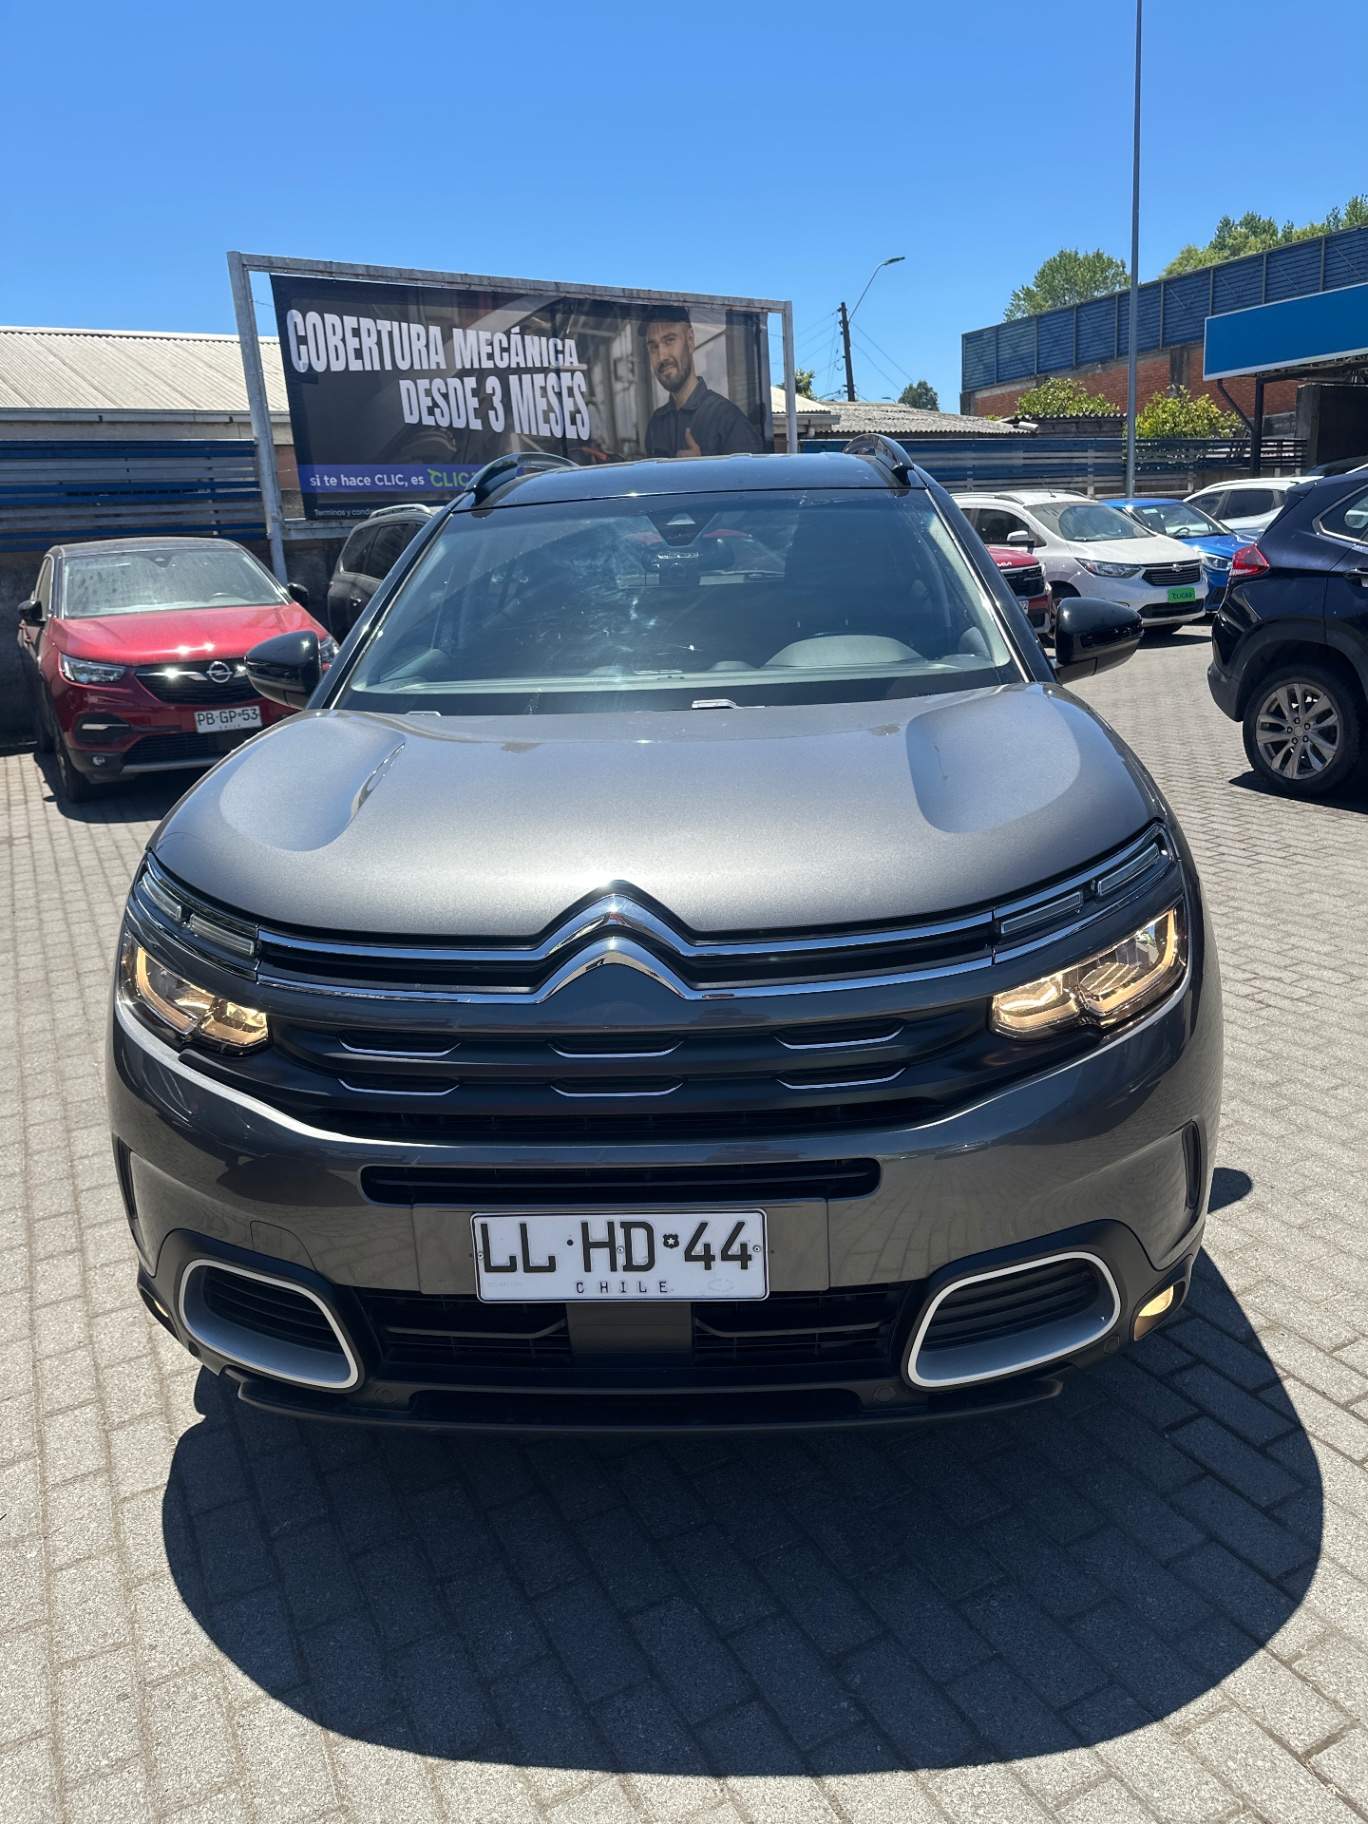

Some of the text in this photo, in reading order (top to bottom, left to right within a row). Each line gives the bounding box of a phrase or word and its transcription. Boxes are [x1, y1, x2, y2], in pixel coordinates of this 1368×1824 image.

[286, 309, 579, 373] COBERTURA MECÁNICA
[400, 371, 591, 441] DESDE 3 MESES
[310, 475, 321, 487] si
[324, 475, 337, 487] te
[341, 474, 371, 487] hace
[374, 474, 408, 488] CLIC,
[411, 476, 425, 486] es
[576, 1280, 669, 1294] CHILE
